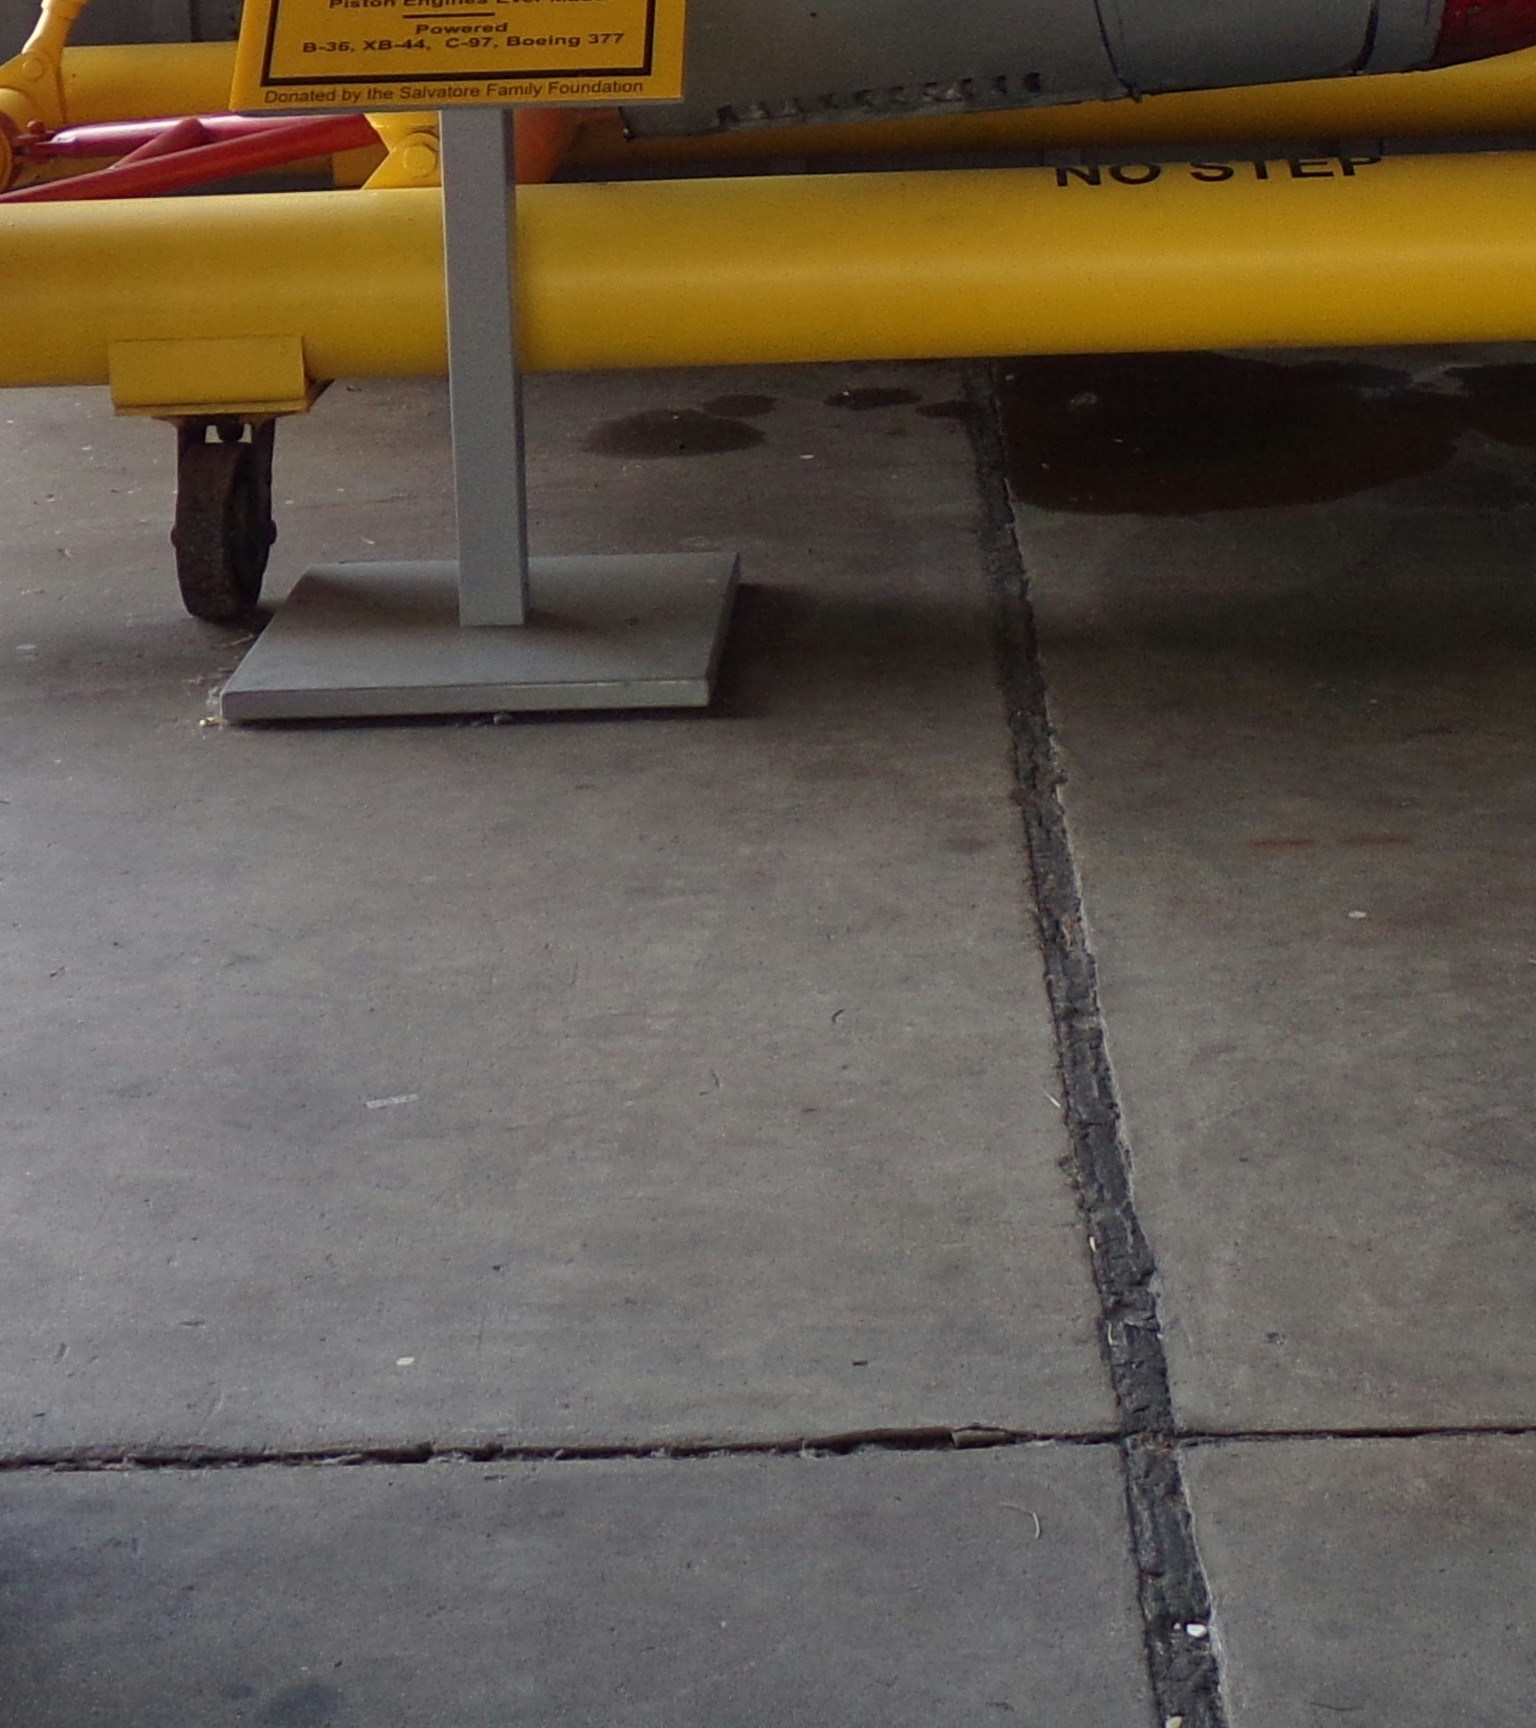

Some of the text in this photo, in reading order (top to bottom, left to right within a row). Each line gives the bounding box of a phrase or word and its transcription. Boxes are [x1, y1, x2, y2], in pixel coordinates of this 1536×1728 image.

[415, 22, 508, 35] Powered
[507, 34, 582, 48] Boeing
[588, 32, 625, 45] 377
[265, 79, 644, 104] Donated by the Salvatore Family Foundation
[1055, 162, 1162, 188] NO
